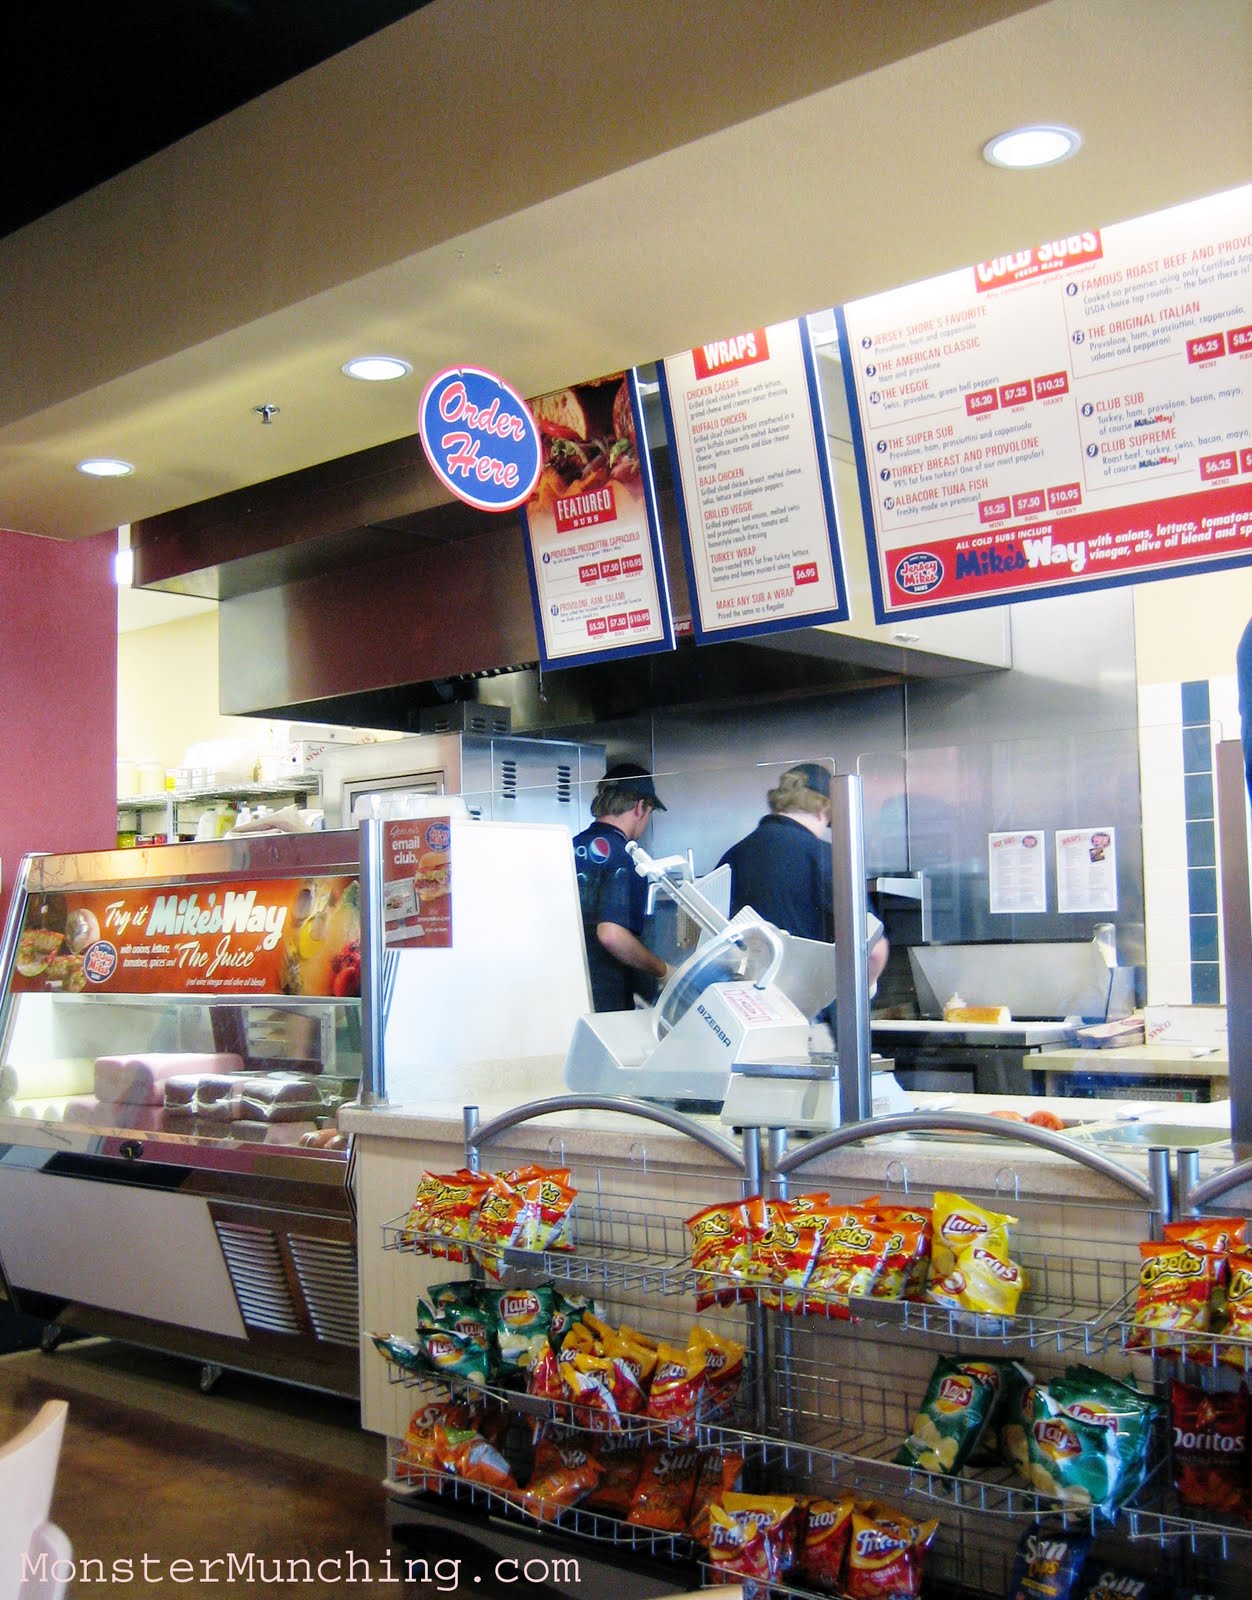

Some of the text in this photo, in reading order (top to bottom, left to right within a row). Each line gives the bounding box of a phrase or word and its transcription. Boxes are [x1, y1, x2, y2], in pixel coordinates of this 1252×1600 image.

[1039, 230, 1099, 259] SUBS
[1080, 270, 1122, 291] FAMOUS
[1126, 260, 1159, 279] ROAST
[1163, 252, 1187, 269] BEEF
[1191, 245, 1214, 261] AND
[872, 305, 987, 345] JERSEY SHORE'S FAVORITE
[1088, 300, 1200, 339] THE ORIGINAL ITALIAN
[703, 331, 757, 371] WRAPS
[877, 336, 980, 372] THE AMERICAN CLASSIC
[1191, 339, 1218, 355] $6.25
[686, 377, 739, 400] CHICKEN CAESAR
[881, 379, 929, 400] THE VEGGIE
[883, 375, 999, 410] Swiss, provolone, green bell peppers
[969, 376, 1065, 409] $5.20 $7.25 $10.25
[1096, 391, 1144, 412] CLUB SUB
[439, 381, 526, 442] Order
[975, 396, 1063, 422] MINI REG GIANT
[1097, 386, 1243, 425] Turkey, ham, provolone, bacon, mayo,
[691, 411, 747, 434] BUFFALO CHICKEN
[888, 425, 953, 449] THE SUPER SUB
[1100, 427, 1176, 453] CLUB SUPREME
[1102, 428, 1251, 465] Roast beef, turkey, swiss, bacon, mayo,
[442, 432, 520, 488] Here
[891, 436, 1039, 478] TURKEY BREAST AND PROVOLONE
[893, 449, 1044, 488] 99% fat free turkey! One of our most popular!
[1205, 458, 1231, 473] $6.25
[699, 467, 744, 486] BAJA CHICKEN
[556, 488, 611, 521] FEATURED
[895, 477, 988, 506] ALBACORE TUNA FISH
[896, 492, 981, 517] Freshly made on premises!
[983, 488, 1078, 517] $5.25 $7.50 $10.95
[573, 514, 599, 527] SUBS
[703, 501, 753, 520] GRILLED VEGGIE
[955, 525, 1052, 550] ALL COLD SUBS INCLUDE
[1087, 532, 1112, 548] with
[1114, 526, 1153, 544] onions,
[1155, 517, 1197, 536] lettuce,
[1089, 524, 1237, 563] vinegar, olive oil blend and
[710, 545, 756, 563] TURKEY WRAP
[901, 559, 936, 574] Jersey
[956, 537, 1086, 580] Mike's Way
[795, 567, 815, 579] $6.95
[904, 570, 937, 587] Mike's
[716, 586, 794, 610] MAKE ANY SUB A WRAP
[913, 584, 928, 592] SUBS
[392, 836, 420, 850] email
[394, 852, 418, 864] club.
[105, 890, 288, 951] Try it Mike's Way
[120, 944, 131, 954] with
[697, 1005, 731, 1047] BIZERBA
[1026, 1536, 1067, 1563] Sun
